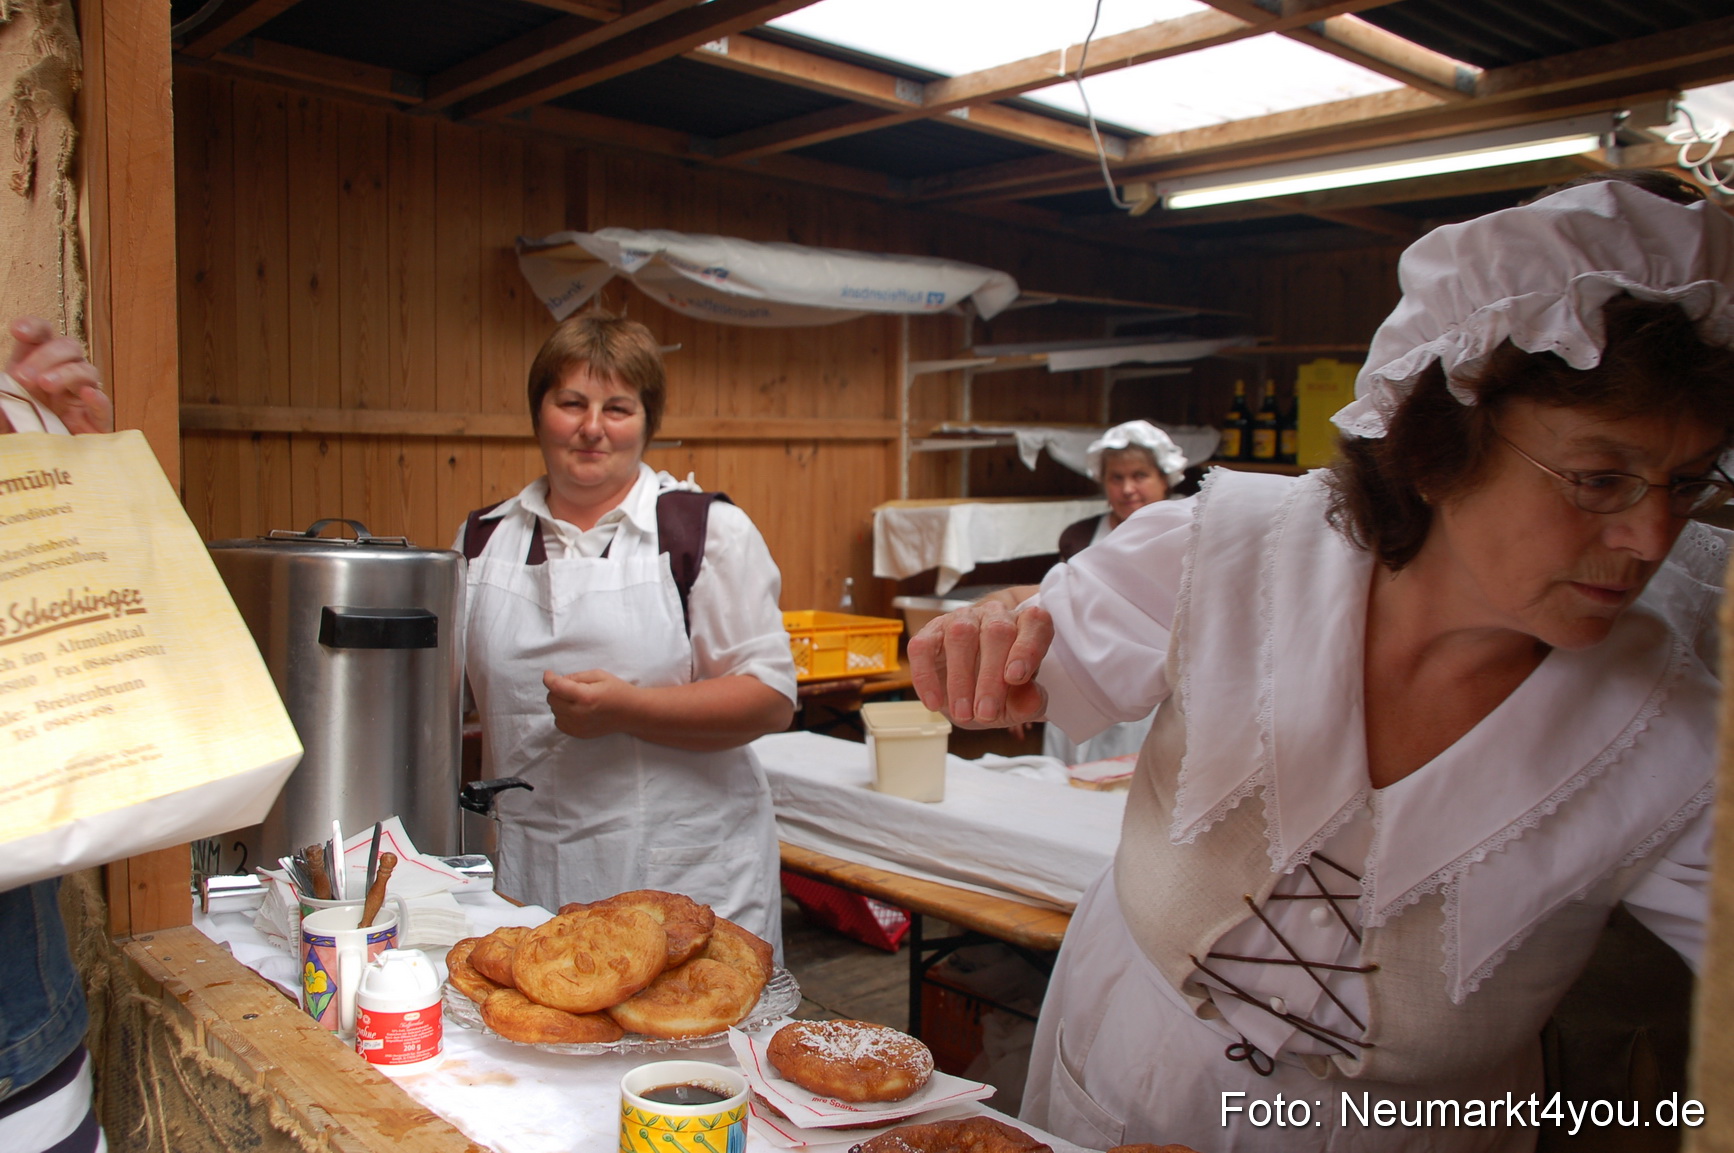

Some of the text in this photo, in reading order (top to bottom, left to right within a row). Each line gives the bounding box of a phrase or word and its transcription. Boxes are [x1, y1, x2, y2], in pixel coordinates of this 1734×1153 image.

[57, 624, 146, 656] Altmühltal
[35, 678, 146, 713] Breitenbrunn
[233, 840, 250, 875] 2
[403, 1044, 416, 1053] 200
